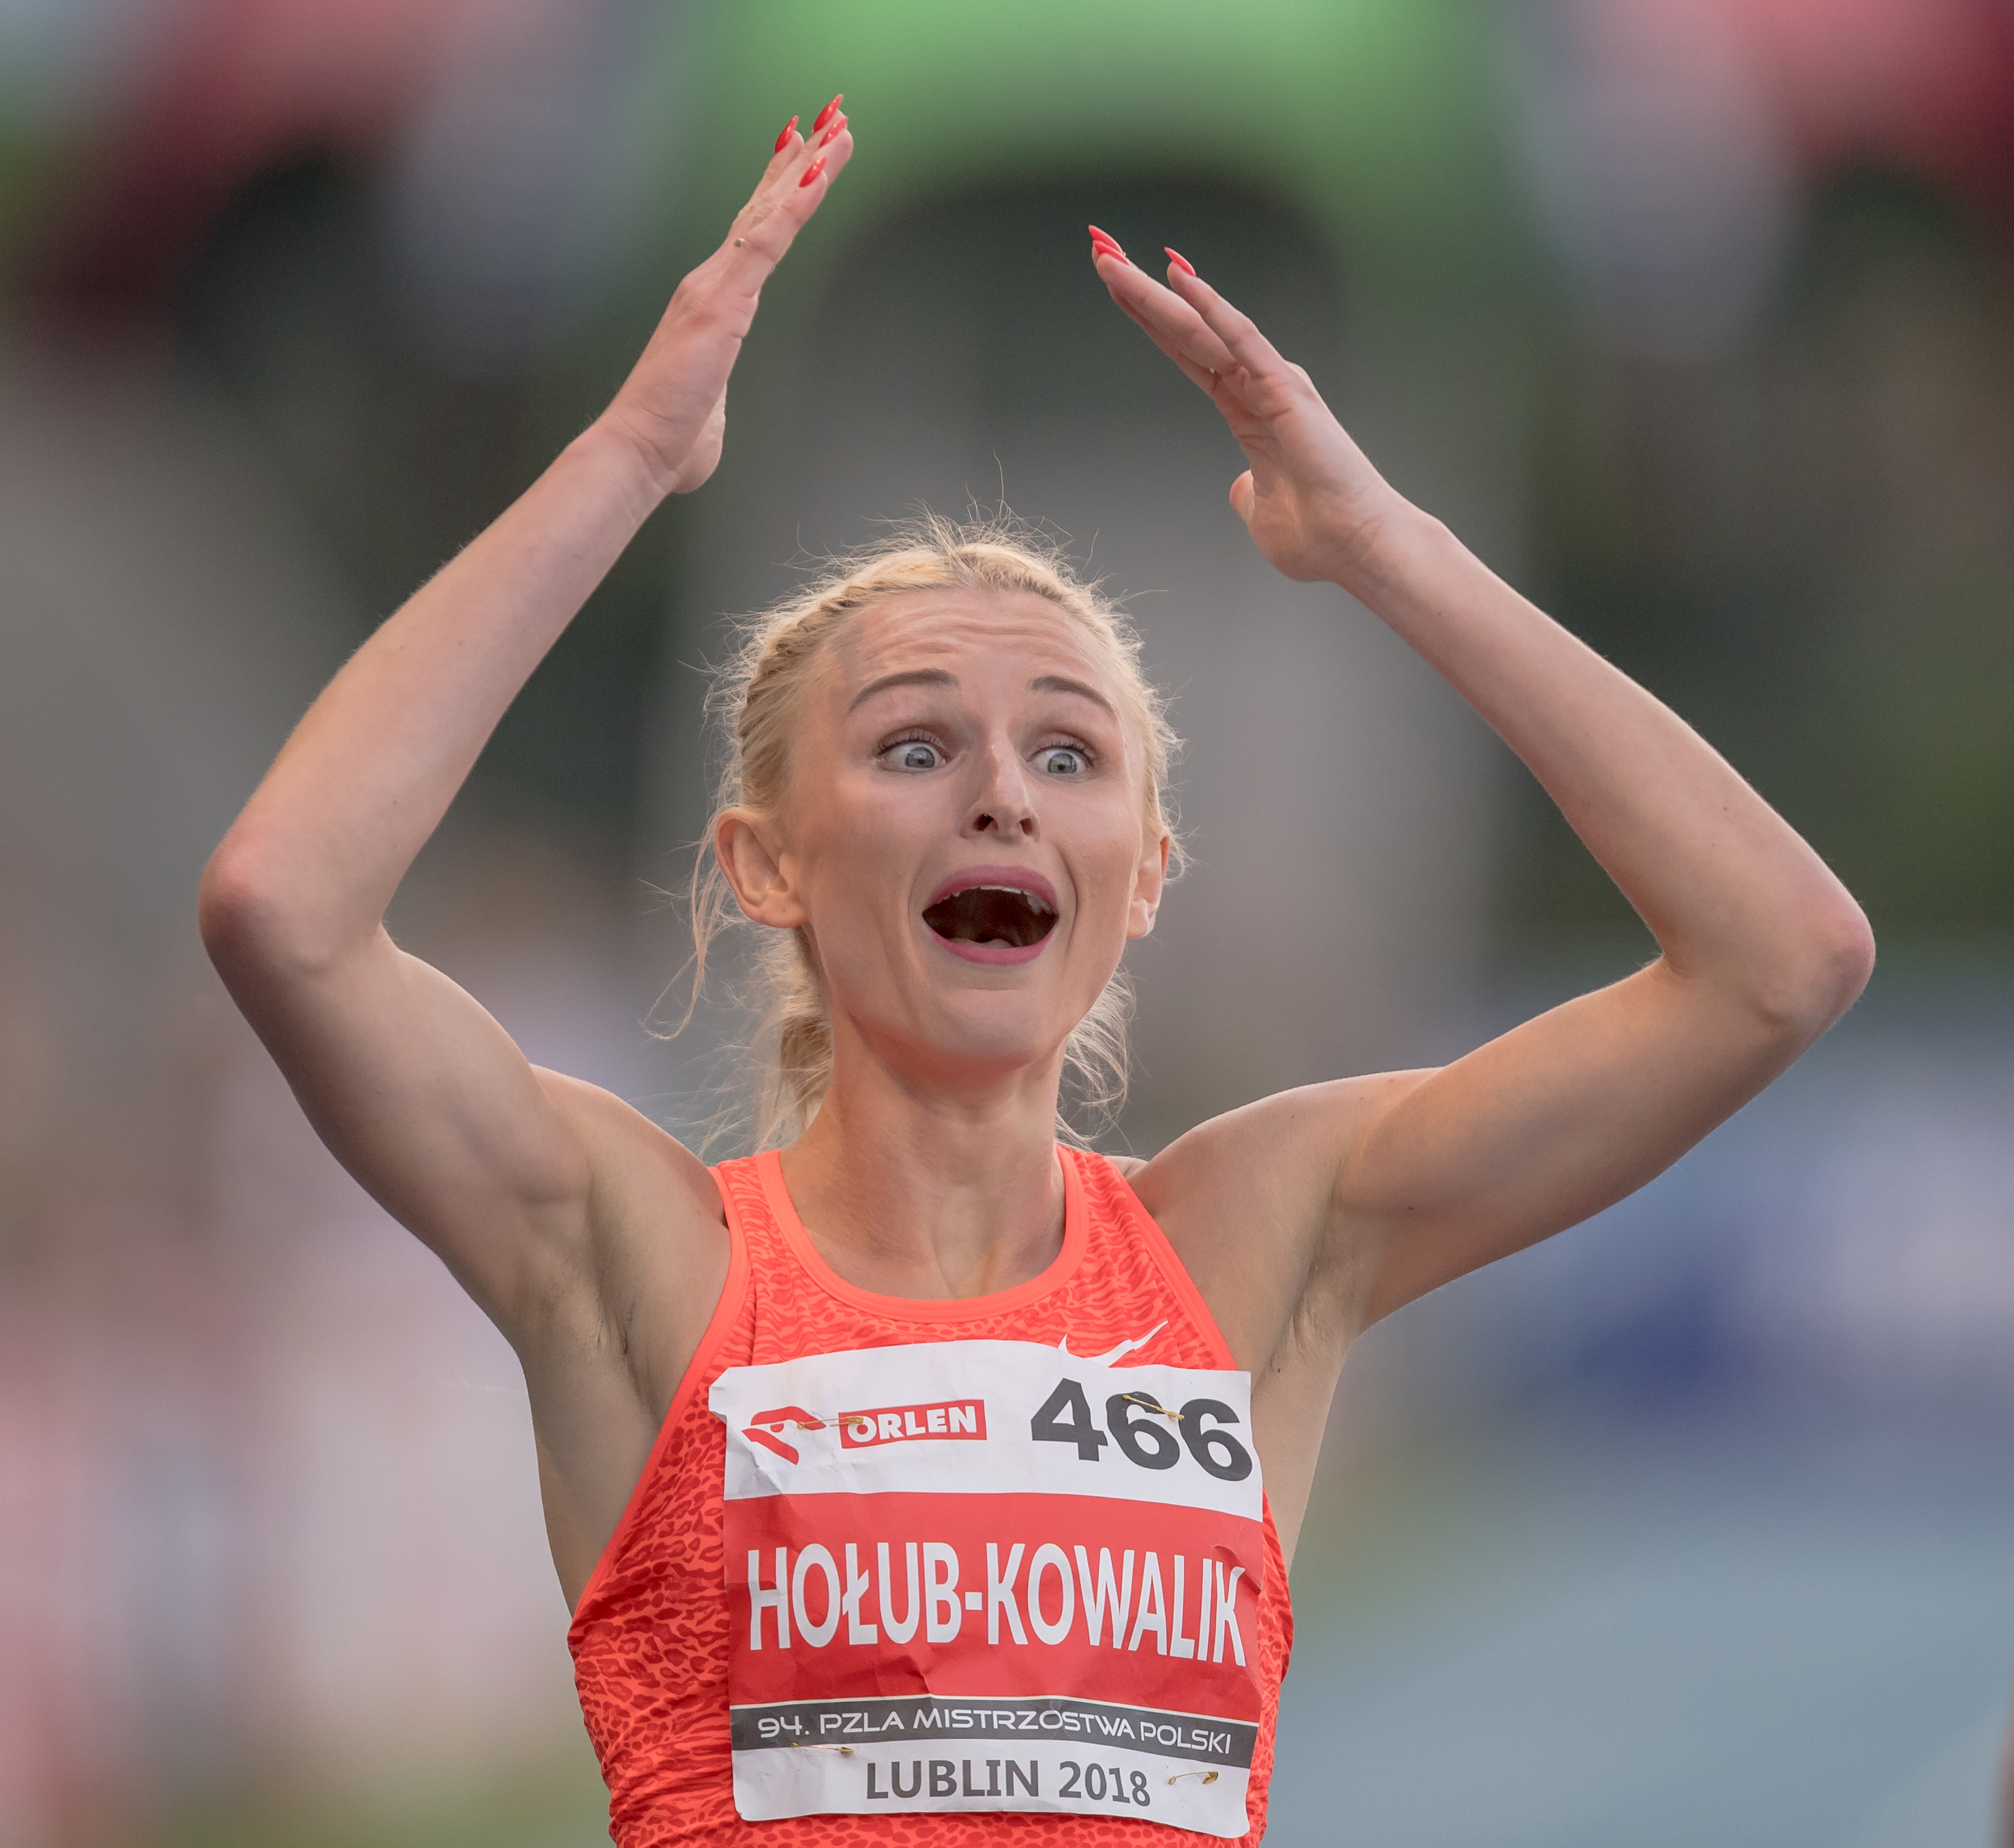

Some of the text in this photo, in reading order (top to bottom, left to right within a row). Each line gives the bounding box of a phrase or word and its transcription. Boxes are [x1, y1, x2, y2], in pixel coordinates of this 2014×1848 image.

[847, 1405, 977, 1443] ORLEN
[1030, 1377, 1253, 1482] 466
[747, 1542, 1247, 1667] HOŁUB-KOWALIK
[758, 1707, 1232, 1755] 94. PZLA MISTRZOSTWA POLSKI
[866, 1759, 1151, 1807] LUBLIN 2018
